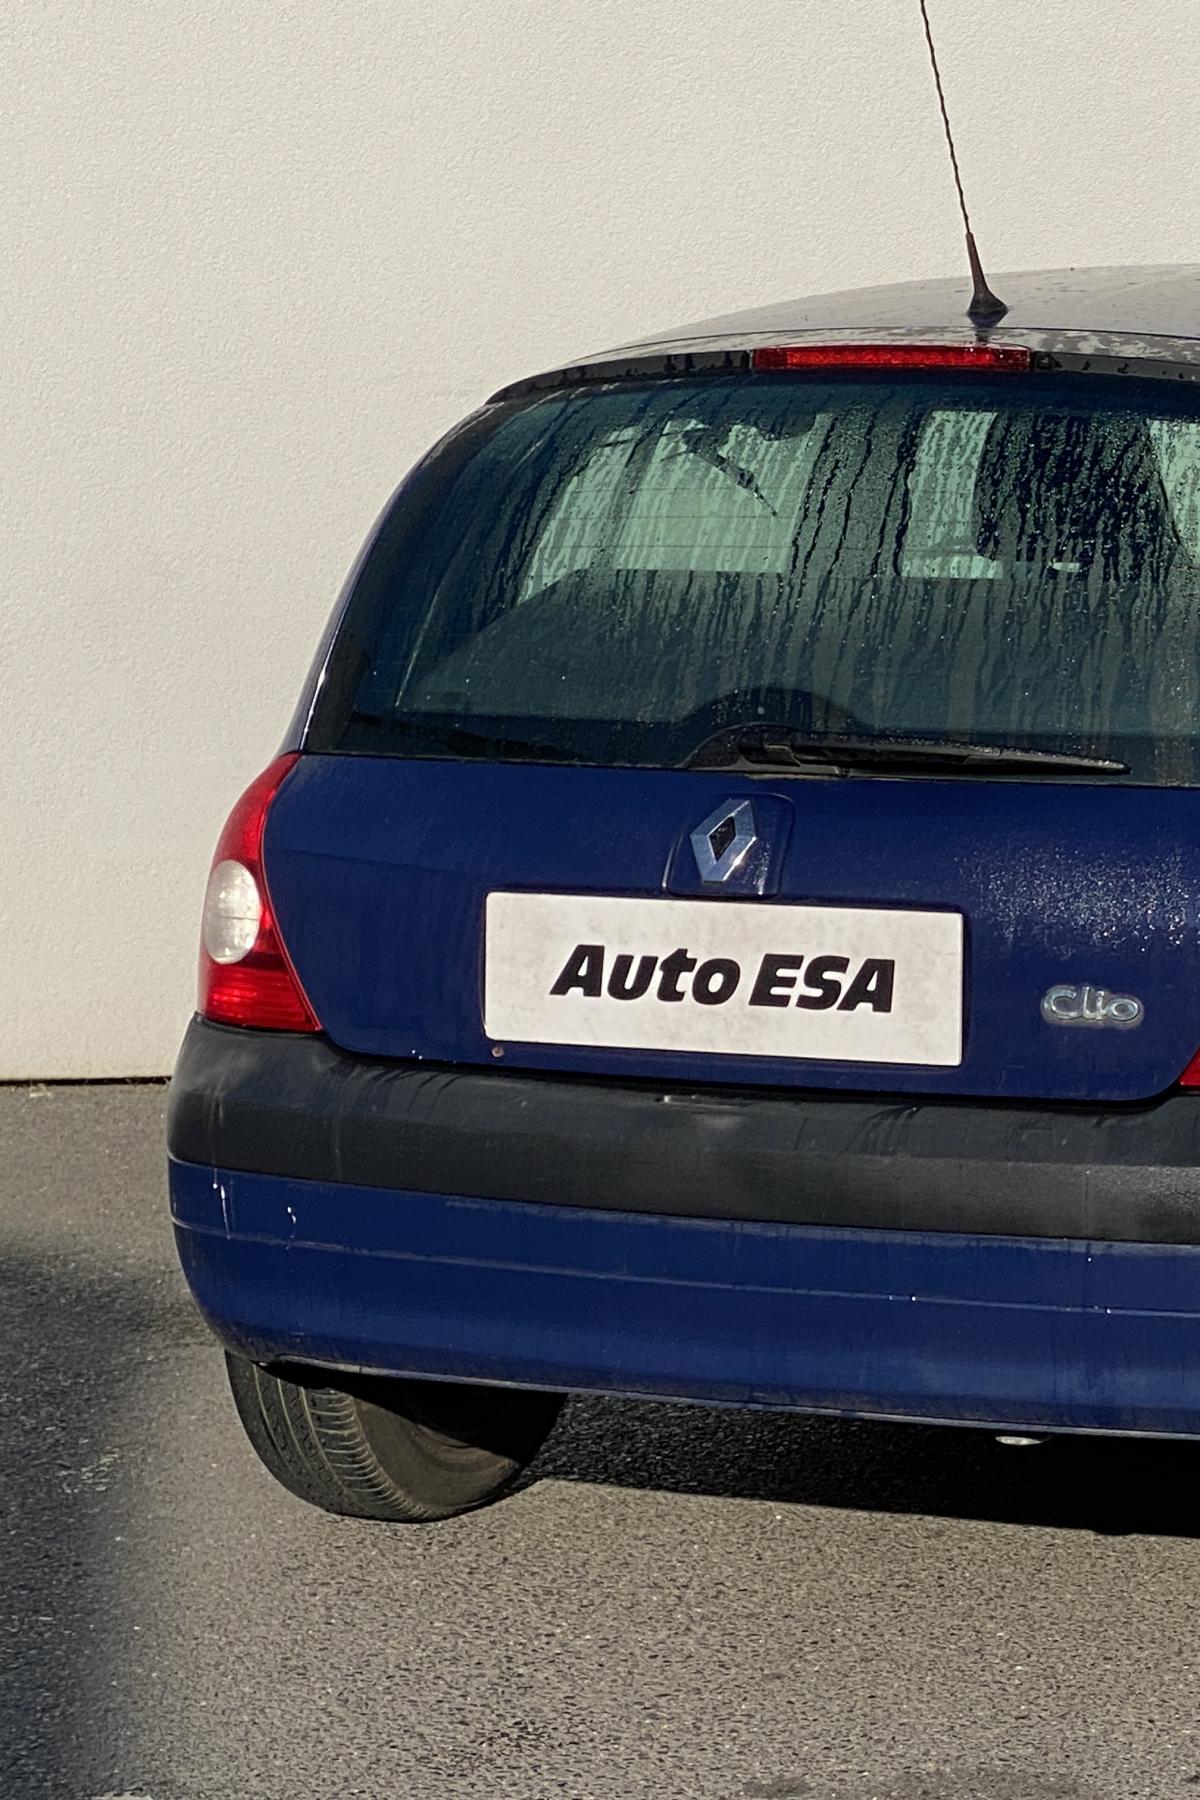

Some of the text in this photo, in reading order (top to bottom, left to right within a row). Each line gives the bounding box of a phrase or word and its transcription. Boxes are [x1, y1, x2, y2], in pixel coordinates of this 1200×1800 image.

[549, 944, 896, 1013] Auto ESA
[1042, 985, 1140, 1022] Clio
